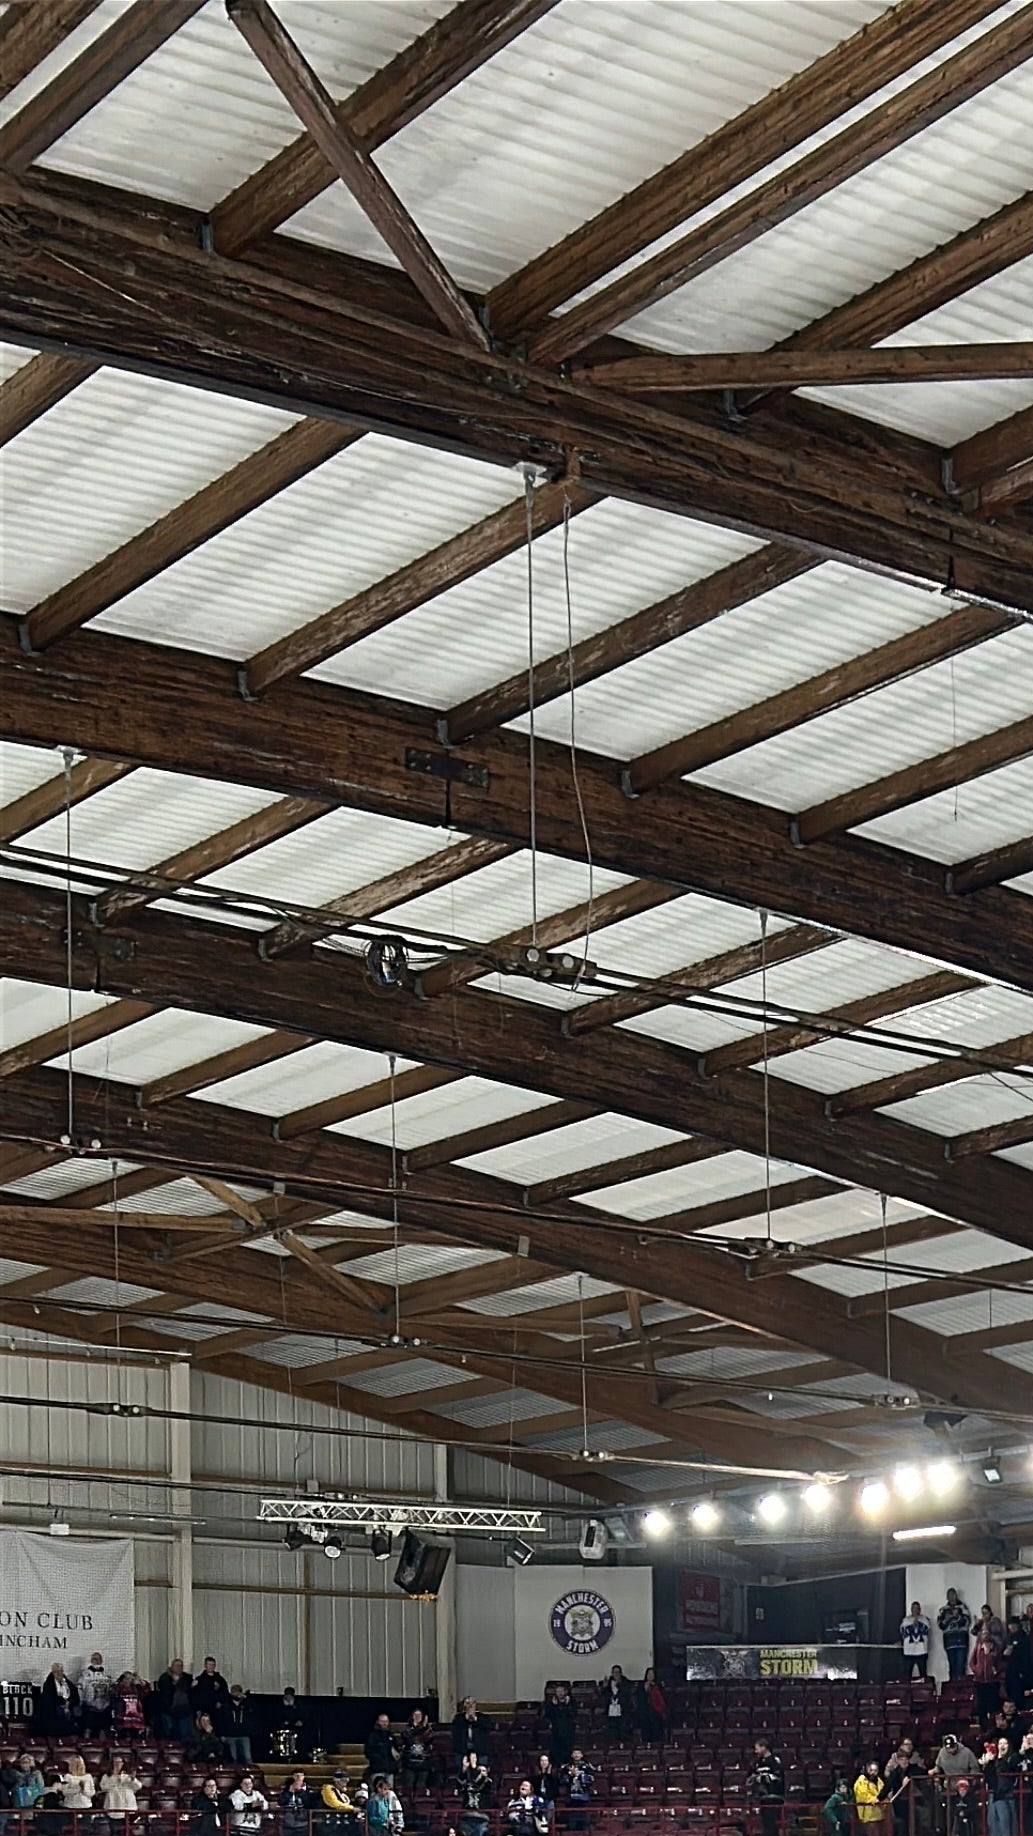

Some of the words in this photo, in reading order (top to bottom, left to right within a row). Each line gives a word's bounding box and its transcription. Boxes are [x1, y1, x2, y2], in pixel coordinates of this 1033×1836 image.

[554, 1592, 609, 1615] MANCHESTER
[37, 1612, 94, 1631] CLUB
[566, 1639, 599, 1653] STORM
[760, 1660, 818, 1676] STORM
[3, 1697, 34, 1717] 110
